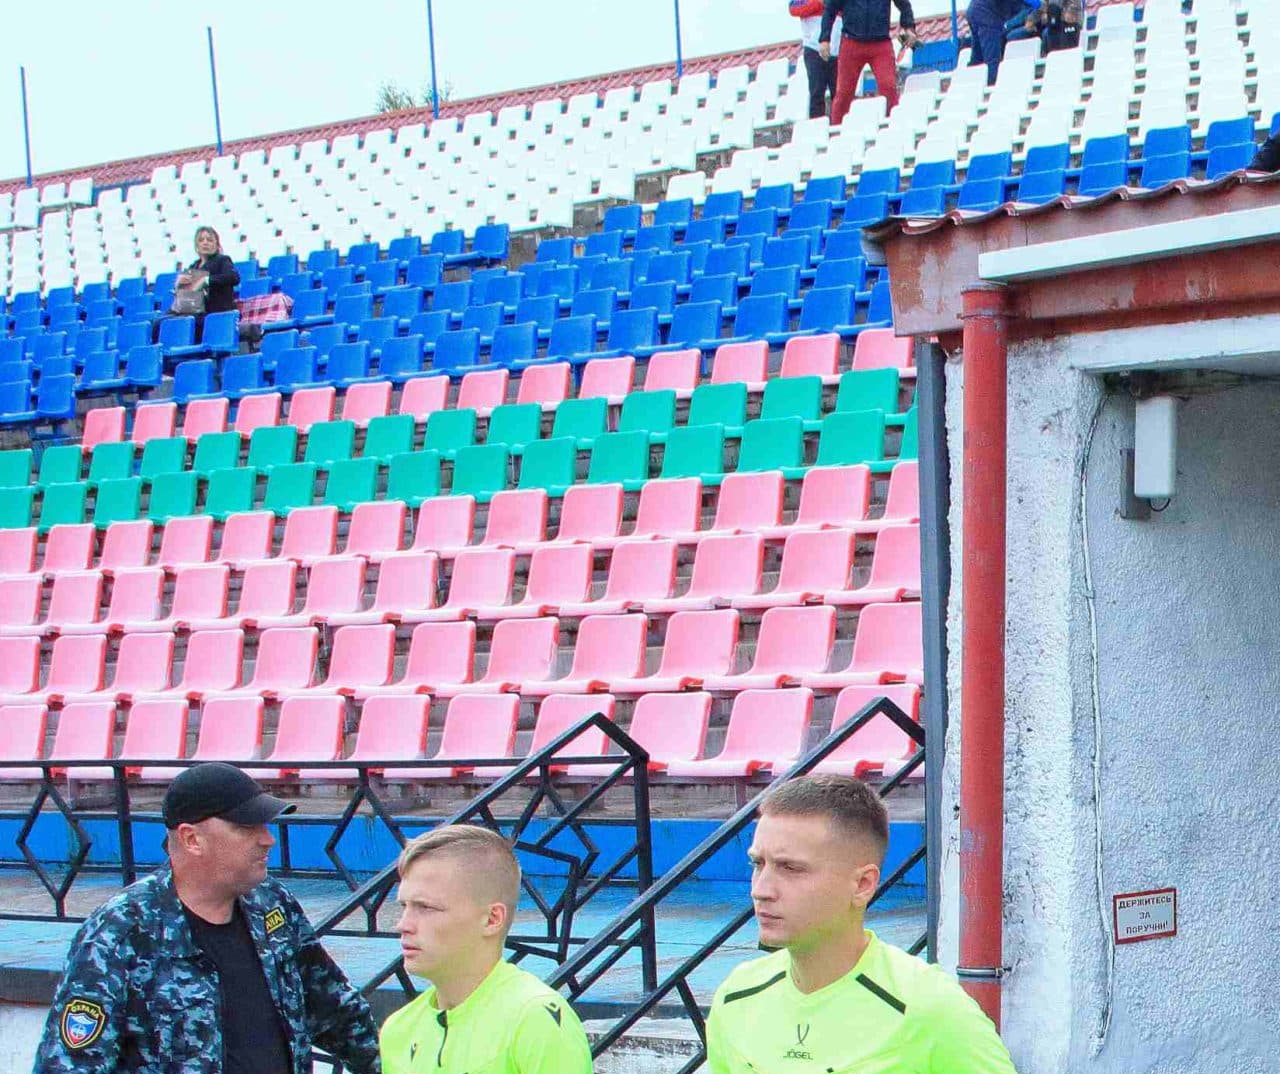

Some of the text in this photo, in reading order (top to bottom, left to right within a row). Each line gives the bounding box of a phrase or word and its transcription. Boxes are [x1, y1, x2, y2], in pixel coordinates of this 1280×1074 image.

[1118, 896, 1171, 909] ДЕРЖИТЕСЬ
[1139, 911, 1150, 920] ЗА
[1126, 920, 1168, 934] ПОРУЧНИ!
[783, 1049, 814, 1061] JÖGEL
